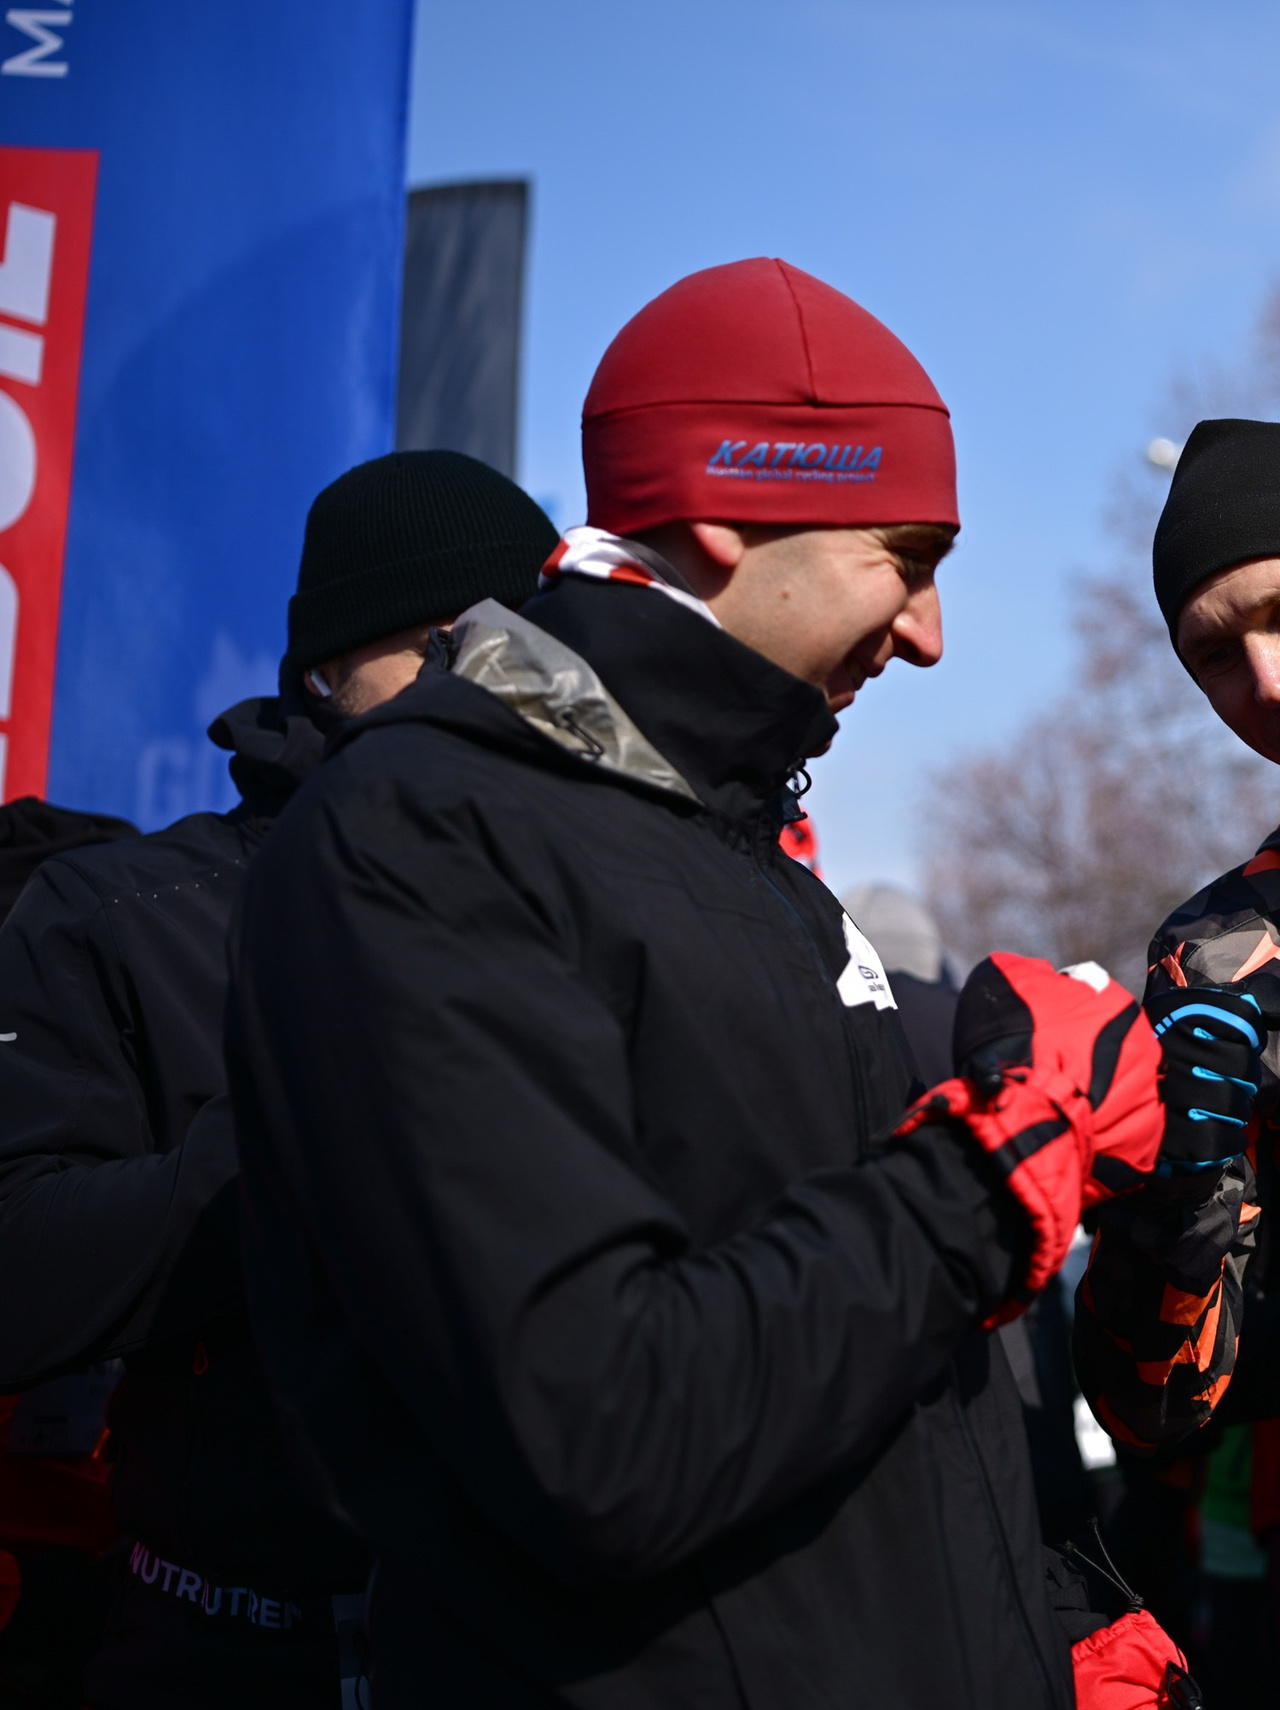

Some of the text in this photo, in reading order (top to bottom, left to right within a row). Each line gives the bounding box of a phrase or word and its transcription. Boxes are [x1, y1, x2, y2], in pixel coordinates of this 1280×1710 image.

[708, 440, 883, 471] КАТЮША
[756, 468, 793, 482] global
[796, 469, 834, 484] cycling
